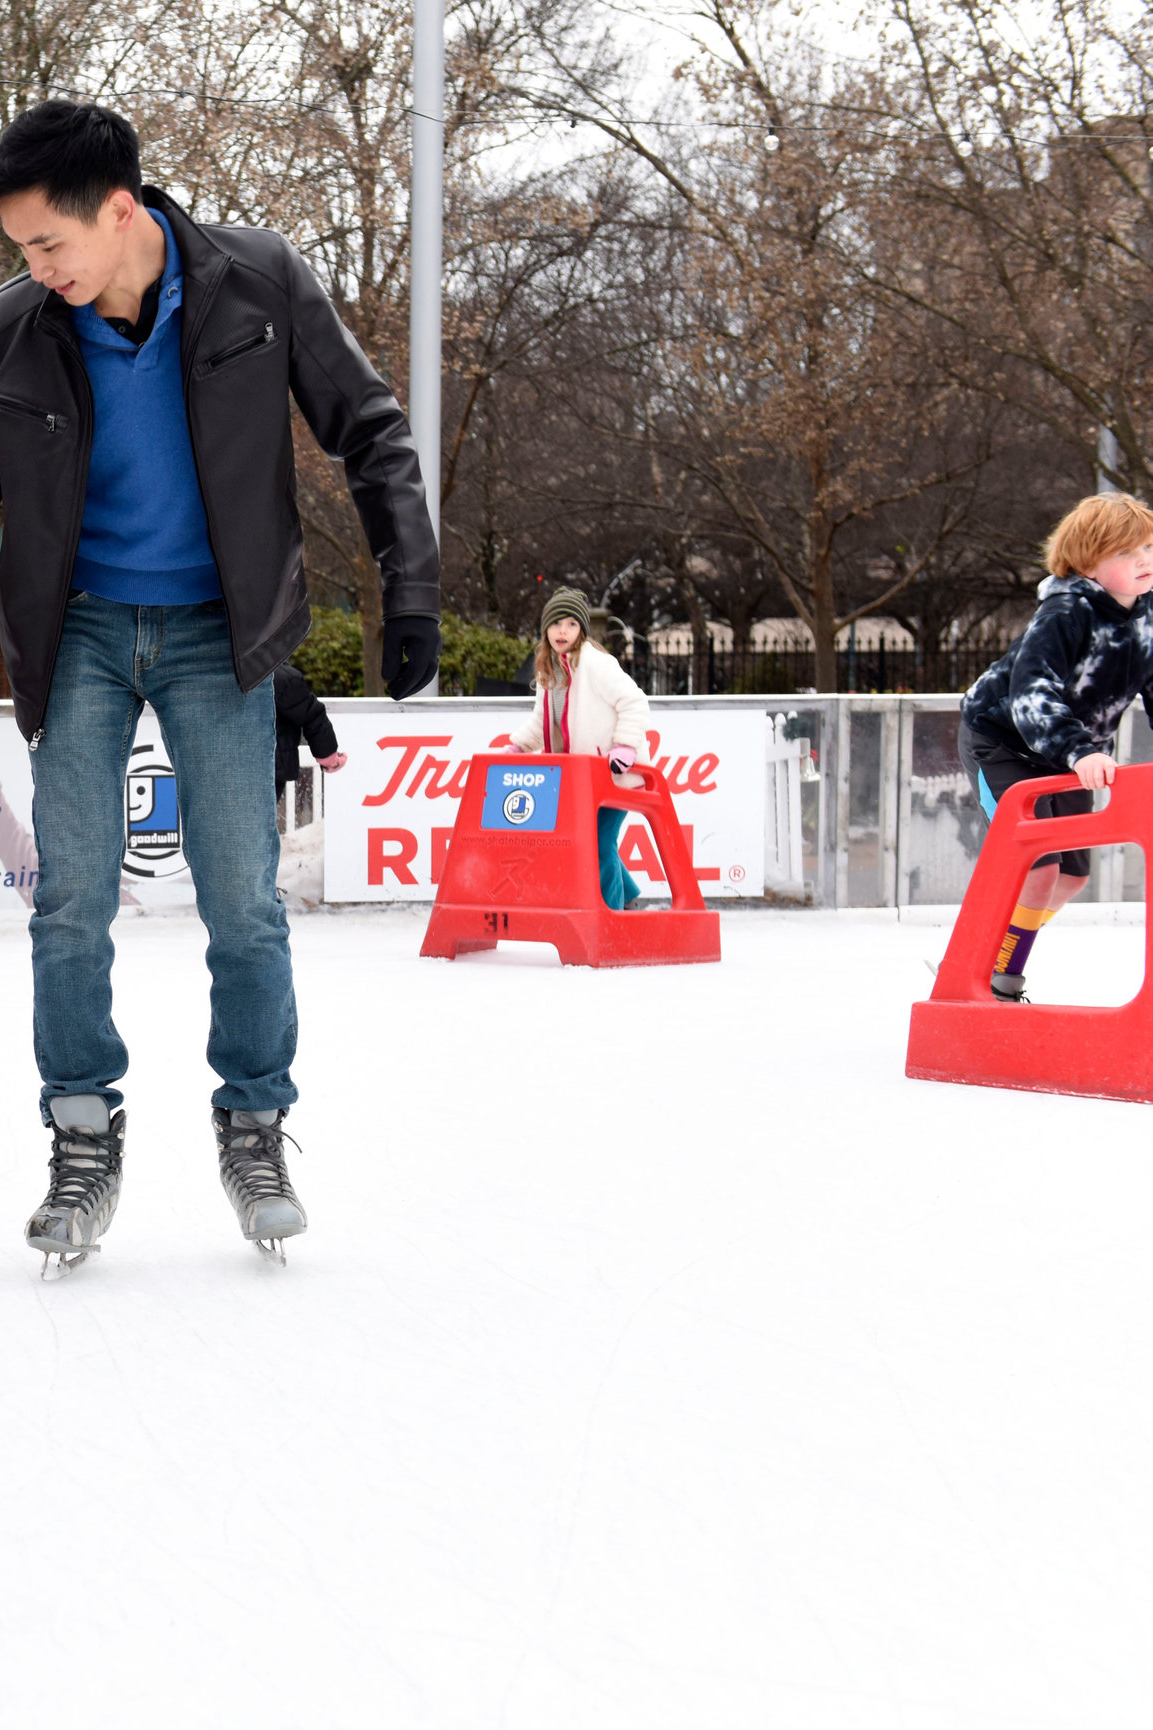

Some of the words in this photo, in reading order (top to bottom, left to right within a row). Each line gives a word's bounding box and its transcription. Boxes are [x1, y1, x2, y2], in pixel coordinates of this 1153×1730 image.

[361, 735, 473, 807] Tru
[502, 772, 546, 788] SHOP
[129, 832, 179, 848] goodwill
[367, 825, 721, 886] RAL
[483, 912, 509, 936] 31
